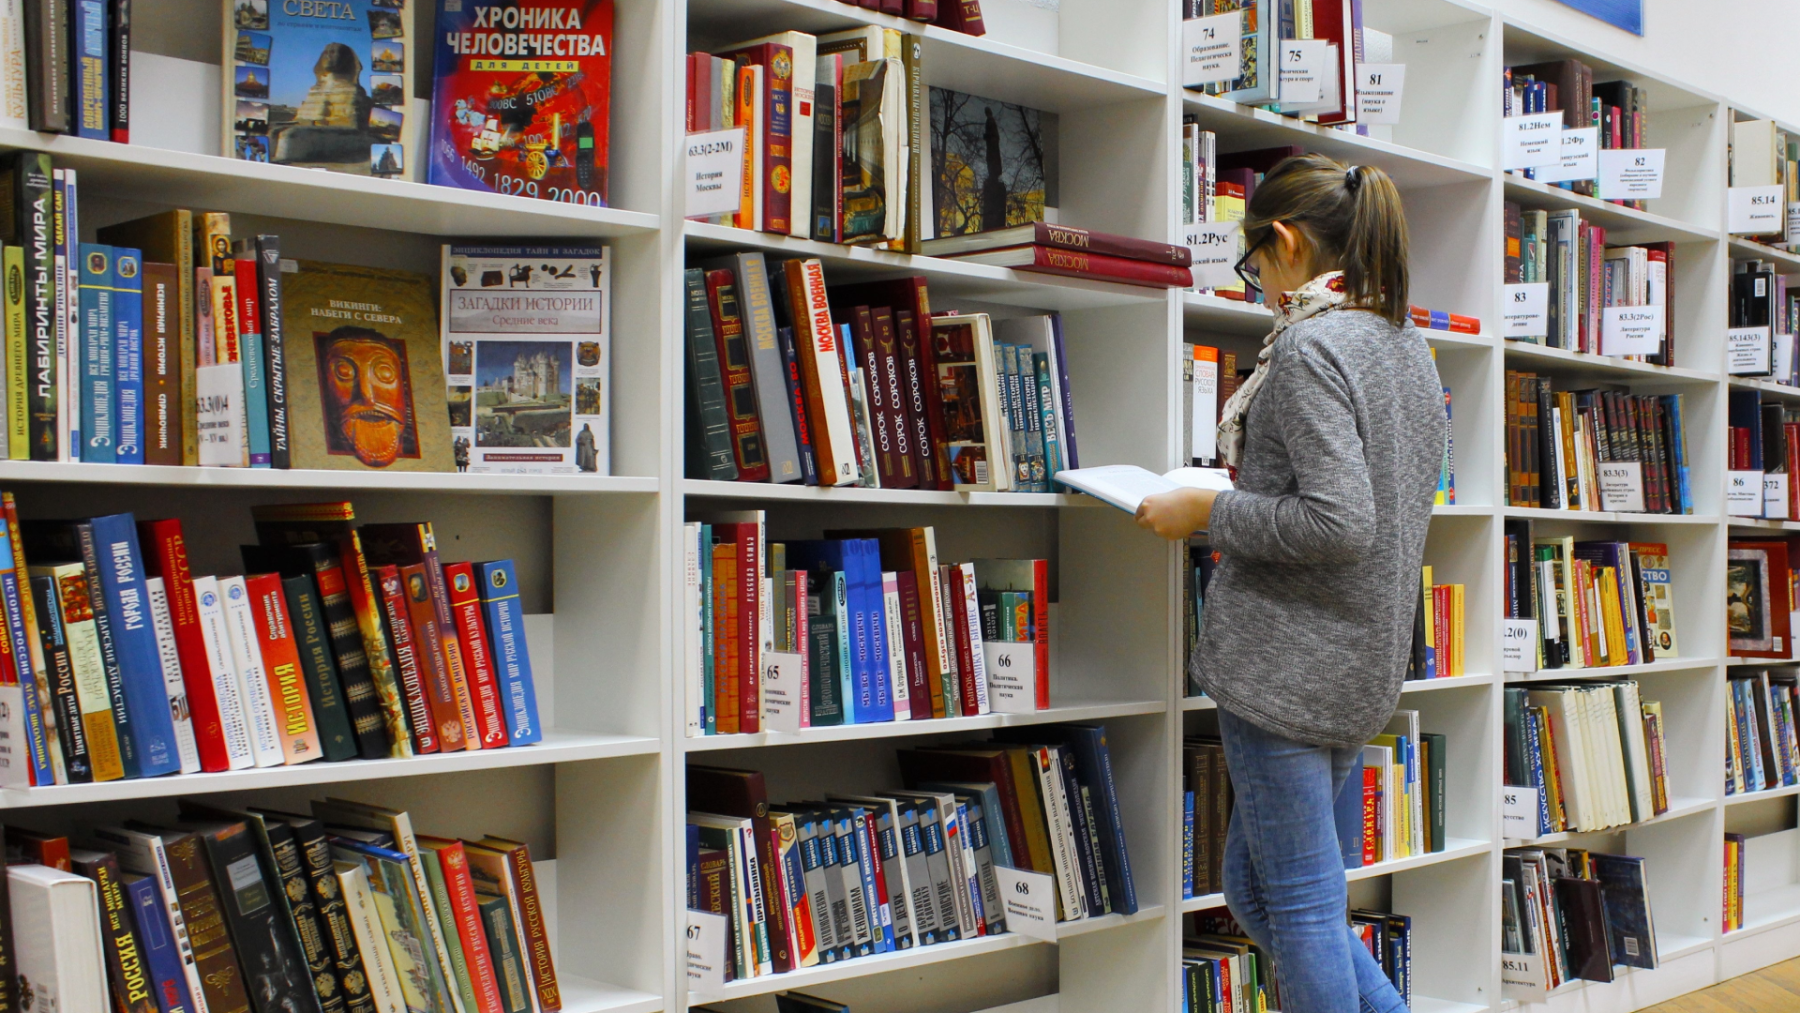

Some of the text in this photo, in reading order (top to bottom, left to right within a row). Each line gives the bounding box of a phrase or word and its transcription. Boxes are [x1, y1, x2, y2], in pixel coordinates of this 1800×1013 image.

[283, 0, 356, 20] СВЕТА
[473, 6, 582, 30] ХРОНИКА
[446, 32, 606, 56] ЧЕЛОВЕЧЕСТВА
[1202, 28, 1215, 40] 74
[475, 61, 574, 70] ДЛЯ ДЕТЕЙ
[1289, 50, 1302, 62] 75
[10, 50, 24, 119] КУЛЬТУРА
[1369, 73, 1382, 86] 81
[119, 104, 127, 122] 1000
[1518, 120, 1551, 131] 81.2Нем
[1520, 139, 1548, 147] Немецкий
[1561, 136, 1585, 147] 1.2Фр
[1634, 157, 1646, 166] 82
[461, 156, 601, 207] 1492 1829 2000
[696, 170, 723, 181] История
[696, 182, 722, 192] Москвы
[54, 190, 64, 246] СДЕЛАЙ САМ!
[1751, 195, 1775, 205] 85.14
[33, 198, 47, 260] МИРА
[1048, 229, 1090, 248] МОСКВА
[1186, 232, 1228, 247] 81.2Рус
[453, 247, 522, 255] ЭНЦИКЛОПЕДИЯ
[525, 247, 548, 255] ТАЙН
[1049, 253, 1089, 270] МОСКВА
[1211, 257, 1228, 265] язык
[311, 307, 402, 324] НАБЕГИ СЕВЕРА
[329, 299, 382, 313] ВИКИНГИ:
[458, 296, 593, 311] ЗАГАДКИ ИСТОРИИ
[745, 259, 775, 350] МОСКВА ВОЕННАЯ
[806, 263, 834, 352] МОСКВА ВОЕННАЯ
[1514, 292, 1527, 302] 83
[34, 266, 51, 398] ЛАБИРИНТЫ
[157, 283, 166, 375] ВСЕМИРНАЯ ИСТОРИЯ
[492, 315, 559, 327] Средние века
[12, 312, 25, 436] ИСТОРИЯ ДРЕВНЕГО МИРА
[268, 278, 286, 451] ТАЙНЫ, СКРЫТЫЕ ЗАБРАЛОМ
[1194, 369, 1216, 379] СЛОВАРЬ
[90, 381, 111, 446] ЭНЦИКЛОПЕДИЯ
[116, 389, 137, 454] ЭНЦИКЛОПЕДИЯ
[158, 393, 167, 449] СПРАВОЧНИК
[793, 387, 809, 445] МОСКВА
[868, 351, 890, 452] СОРОК СОРОКОВ
[885, 355, 908, 454] СОРОК СОРОКОВ
[907, 358, 930, 457] СОРОК СОРОКОВ
[1041, 385, 1057, 442] ВЕСЬ МИР
[1603, 470, 1628, 478] 83.3(3)
[1733, 478, 1744, 486] 86
[111, 541, 144, 630] ГОРОДА РОССИИ
[5, 577, 30, 675] ИСТОРИЯ РОССИИ
[261, 594, 277, 640] Справочник
[270, 591, 287, 639] абитуриента
[856, 612, 866, 661] МОСКВИЧИ
[297, 593, 336, 708] История России
[718, 583, 727, 693] РУССКИЙ ПРАЗДНИК
[872, 612, 886, 705] МЫ ВСЕ МОСКВИЧИ
[967, 607, 986, 707] ЭКОНОМИКА БИЗНЕС
[98, 615, 128, 724] ЦАРСКИЕ ДИНАСТИИ
[767, 665, 779, 679] 65
[817, 633, 833, 705] ЭКОНОМИЧЕСКИЙ
[842, 641, 850, 681] ЭКОНОМИКА
[895, 659, 904, 687] Островская
[998, 654, 1011, 667] 66
[24, 683, 36, 710] АТЛАС
[245, 668, 269, 751] ИСТОРИЯ ОТЕЧЕСТВА
[274, 663, 309, 735] ИСТОРИЯ
[397, 646, 429, 735] ЭНЦИКЛОПЕДИЯ
[447, 642, 475, 739] РОССИЙСКАЯ ИМПЕРИЯ
[509, 681, 532, 738] ЭНЦИКЛОПЕДИЯ
[862, 690, 870, 706] МЫ
[965, 674, 976, 707] РЫНОК:
[215, 675, 238, 759] ИСТОРИЯ ОТЕЧЕСТВА
[476, 685, 502, 742] ЭНЦИКЛОПЕДИЯ
[1536, 751, 1542, 766] XX
[1504, 794, 1517, 806] 85
[1538, 770, 1549, 829] ИСКУССТВО
[1045, 775, 1076, 904] БОЛЬШАЯ ЭНЦИКЛОПЕДИЯ ВЫЖИВАНИЯ
[516, 849, 535, 893] КУЛЬТУРЫ
[858, 830, 879, 926] ПРЕСТУПНИКИ ПРЕСТУПЛЕНИЯ
[1016, 881, 1029, 895] 68
[98, 866, 121, 930] ВСЕ МОНАРХИ
[111, 881, 124, 910] МИРА
[524, 895, 542, 938] РУССКОЙ
[749, 857, 770, 962] Справочник ПРИЗЫВНИКА
[850, 886, 868, 940] ЖЕНЩИНАМ
[893, 892, 907, 920] ДЕТЯХ
[913, 888, 927, 930] ОБРАТИТЕСЬ
[920, 886, 934, 920] АДВОКАТУ
[936, 879, 955, 927] ПРАВОСУДИЕ
[1008, 900, 1028, 909] Военное
[1008, 907, 1028, 918] Военная
[687, 924, 701, 940] 67
[815, 890, 834, 946] АВТОЛЮБИТЕЛЯМ
[455, 873, 499, 1013] ТЫСЯЧЕЛЕТИЕ РУССКОЙ ИСТОРИИ
[530, 940, 552, 983] ИСТОРИЯ
[115, 931, 149, 1004] РОССИЯ
[1502, 960, 1529, 974] 85.11
